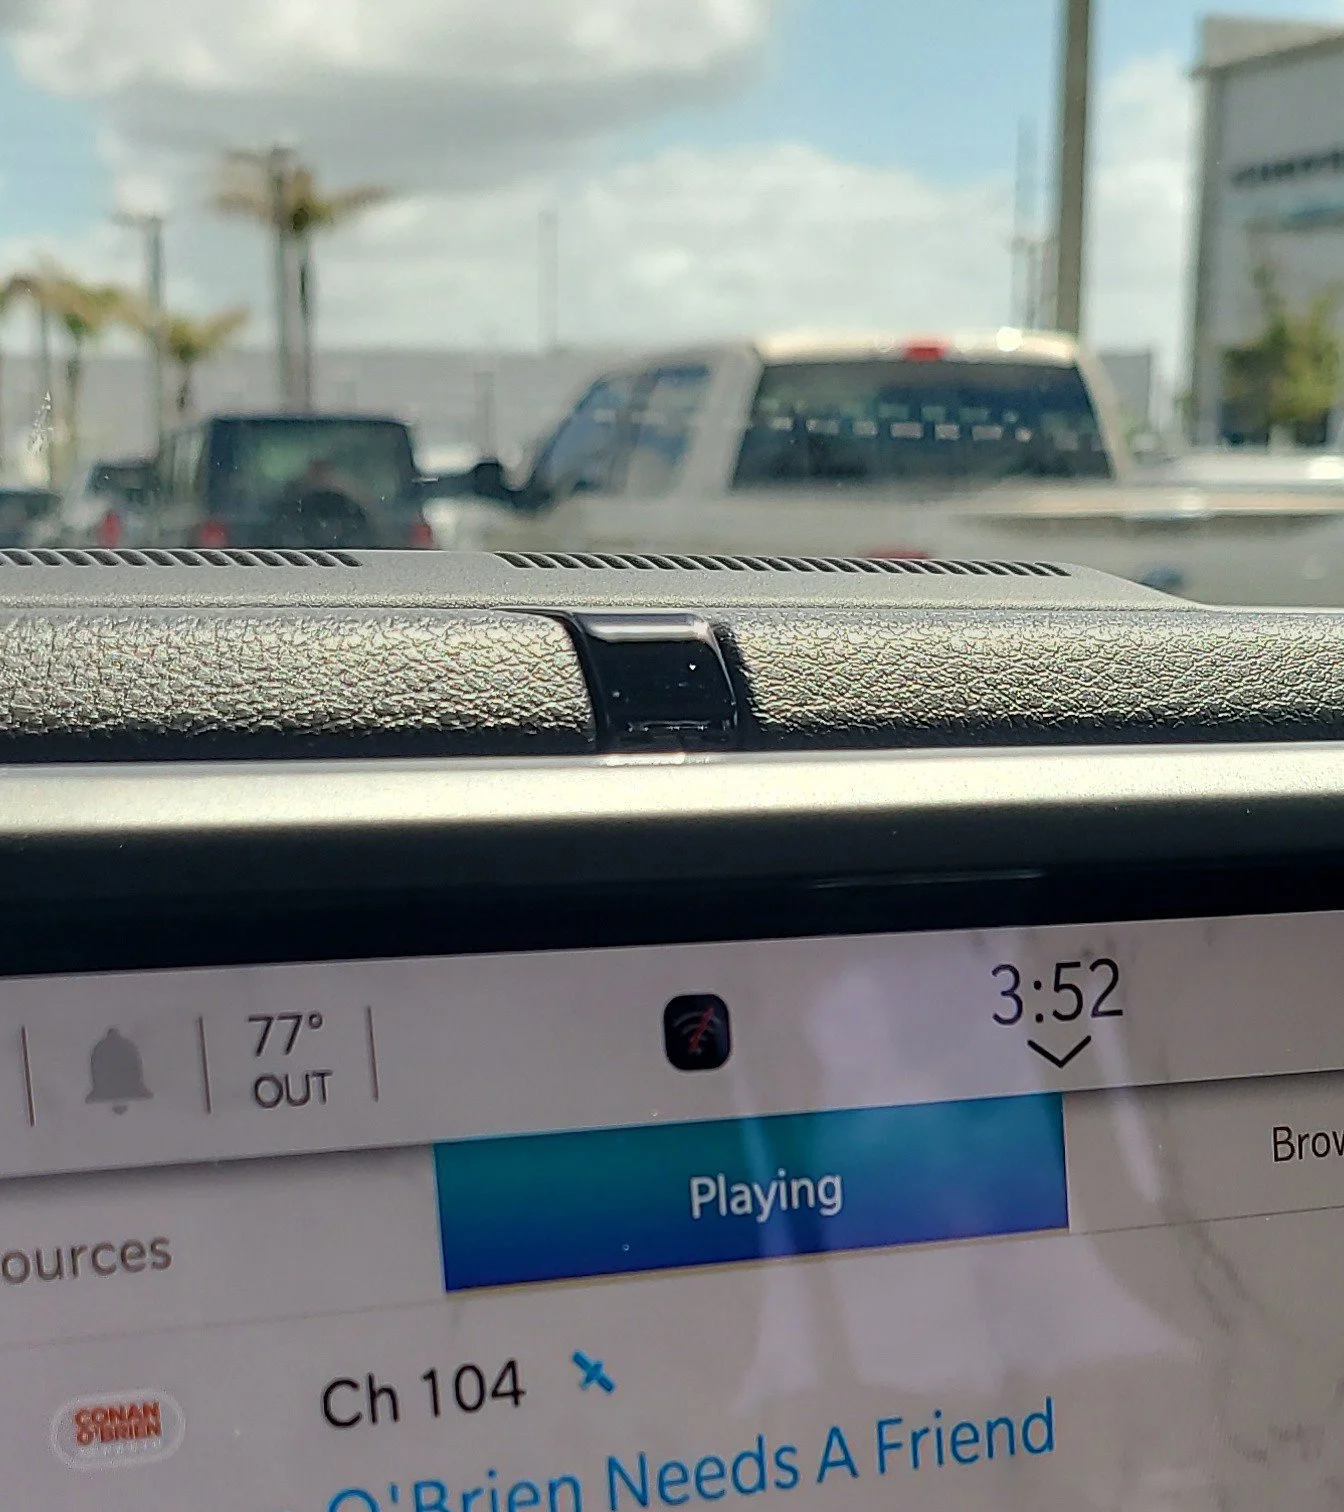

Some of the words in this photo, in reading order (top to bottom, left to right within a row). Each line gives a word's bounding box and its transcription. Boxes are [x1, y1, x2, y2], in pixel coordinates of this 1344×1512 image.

[990, 957, 1124, 1028] 3:52
[246, 1012, 324, 1058] 77°
[253, 1069, 333, 1110] OUT
[689, 1167, 844, 1224] Playing
[322, 1372, 401, 1430] Ch
[421, 1358, 526, 1418] 104
[606, 1433, 800, 1512] Needs
[816, 1425, 861, 1484] A
[874, 1396, 1056, 1475] Friend
